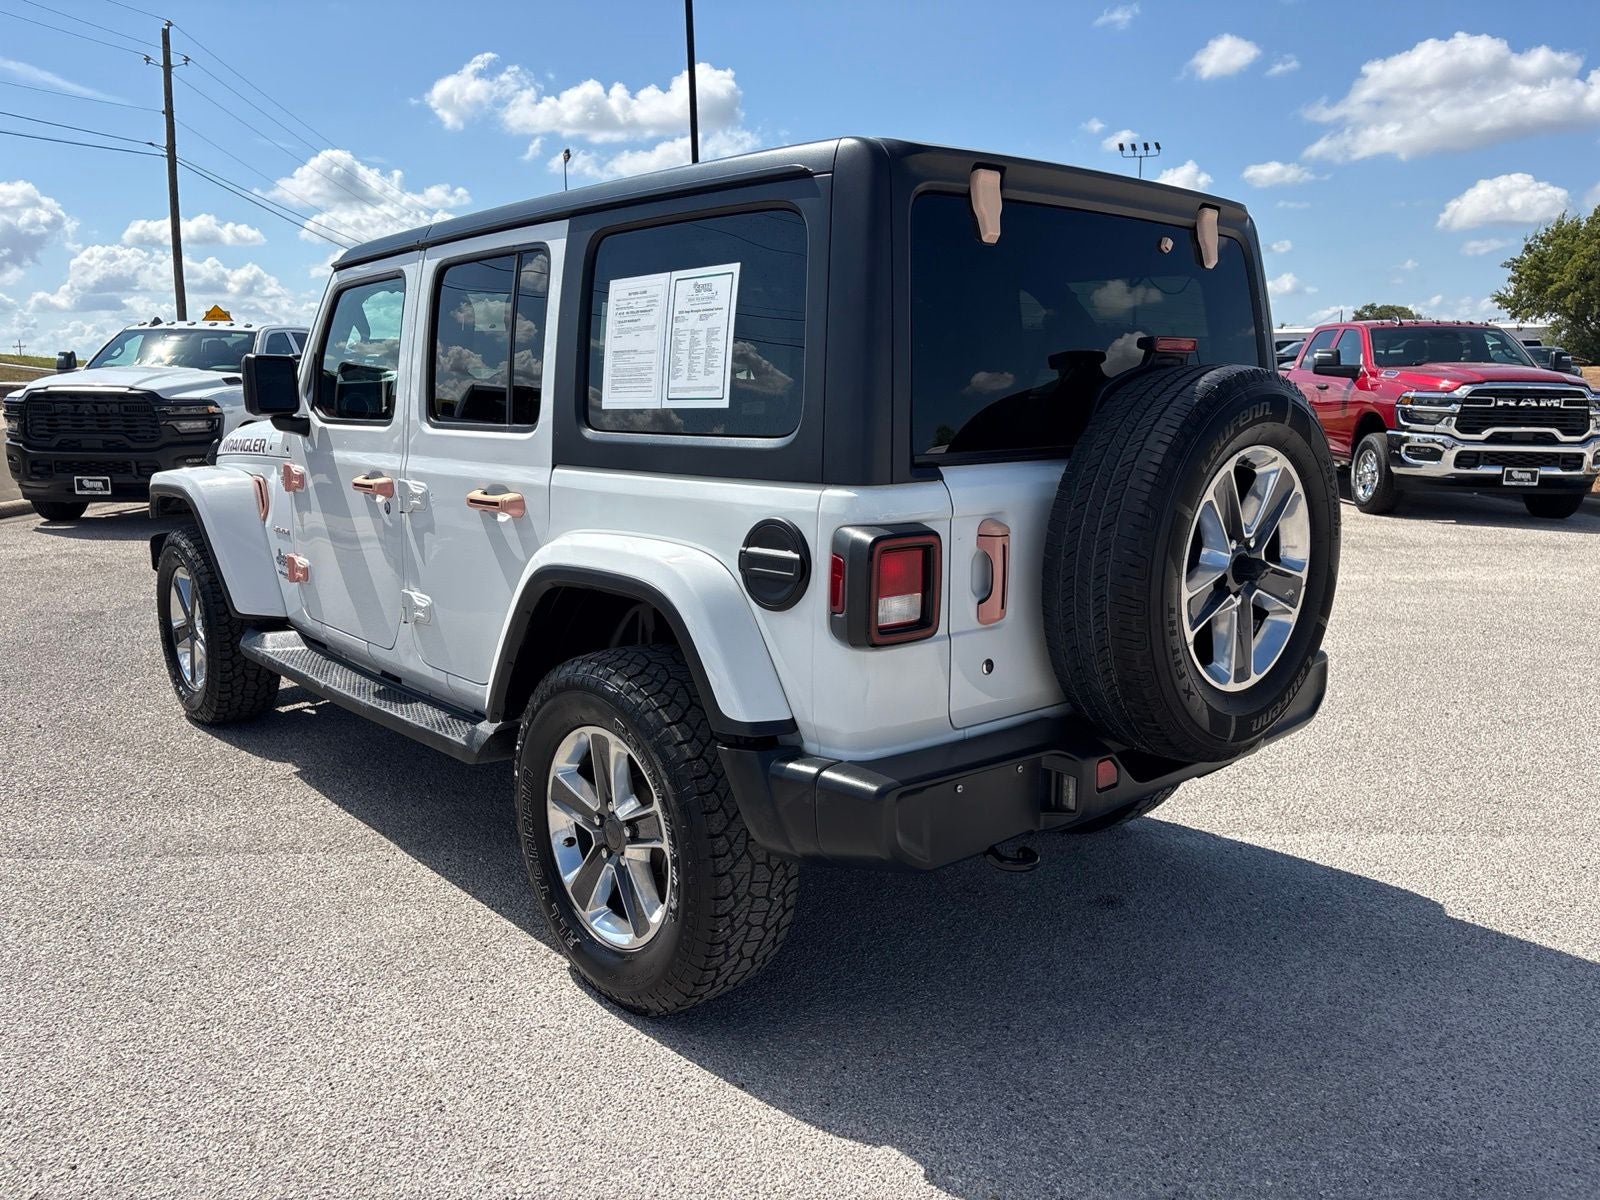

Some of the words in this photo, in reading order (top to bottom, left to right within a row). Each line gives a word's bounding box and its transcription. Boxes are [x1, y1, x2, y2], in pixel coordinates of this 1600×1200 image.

[54, 403, 120, 415] RAM
[1496, 398, 1561, 407] RAM
[222, 438, 267, 454] WRANGLER
[1182, 681, 1197, 702] X
[521, 766, 550, 900] TERRAIN
[550, 902, 581, 951] ALL
